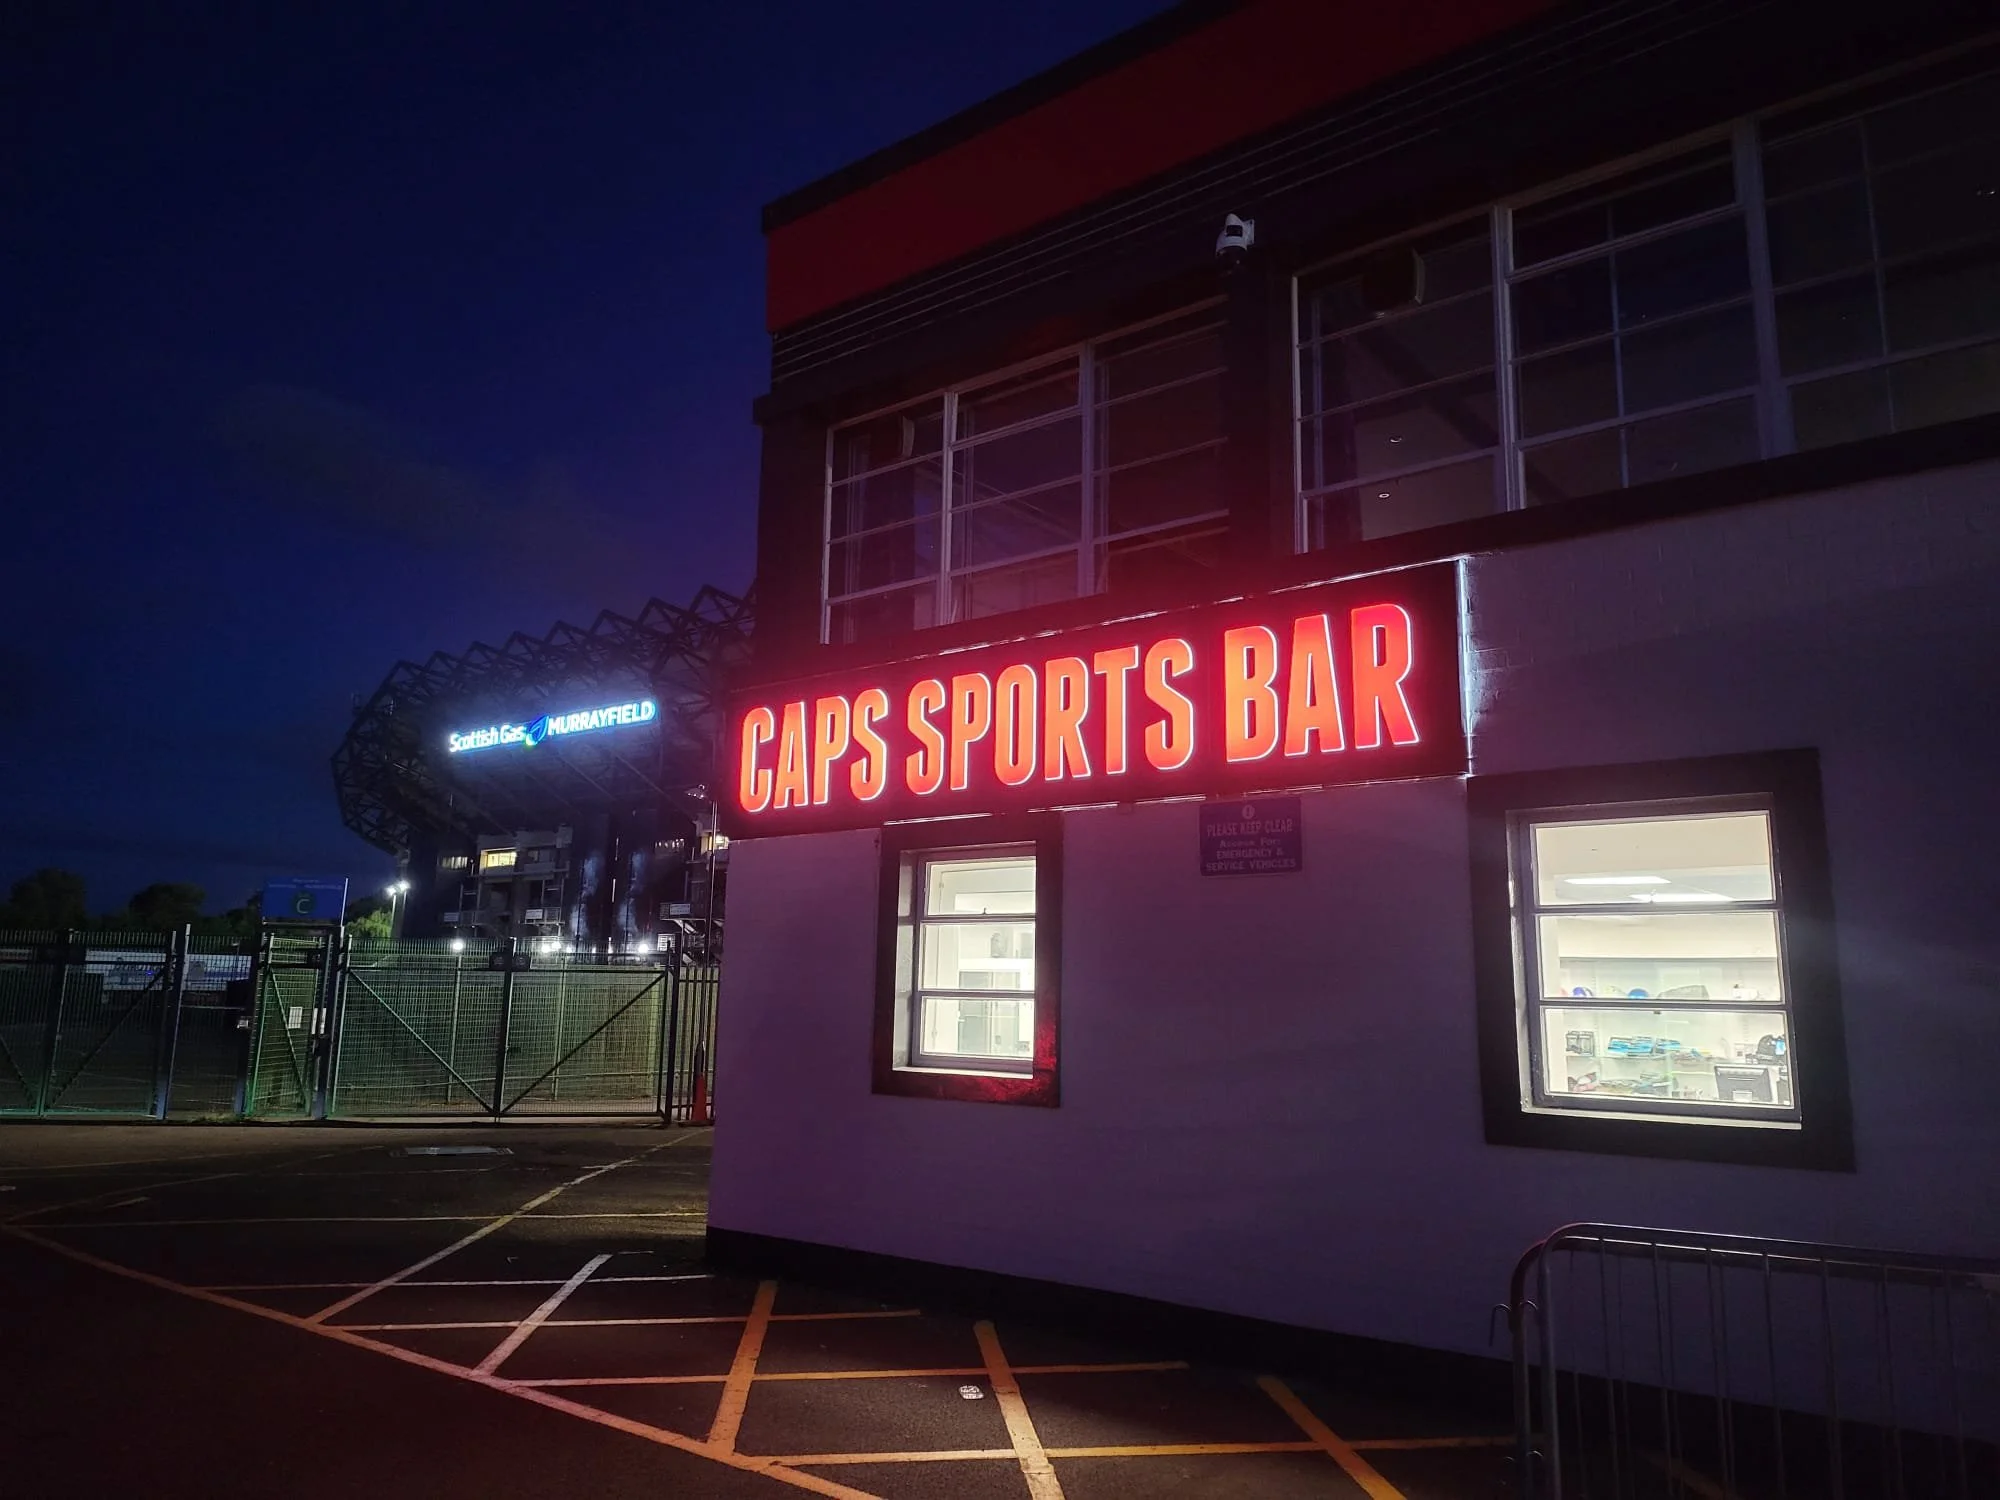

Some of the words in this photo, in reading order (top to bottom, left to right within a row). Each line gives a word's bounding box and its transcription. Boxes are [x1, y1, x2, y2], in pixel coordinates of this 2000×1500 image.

[738, 687, 889, 813] CAPS
[905, 637, 1194, 796] SPORTS
[1223, 602, 1420, 763] BAR
[450, 726, 500, 752] Scottish
[501, 724, 527, 744] Gas
[547, 700, 655, 735] MURRAYFIELD
[1207, 822, 1238, 837] PLEASE
[1240, 820, 1262, 834] KEEP
[1265, 818, 1293, 833] CLEAR
[1216, 847, 1272, 860] EMERGENCY
[1206, 860, 1245, 872] SERVICE
[1249, 858, 1296, 870] VEHICLES
